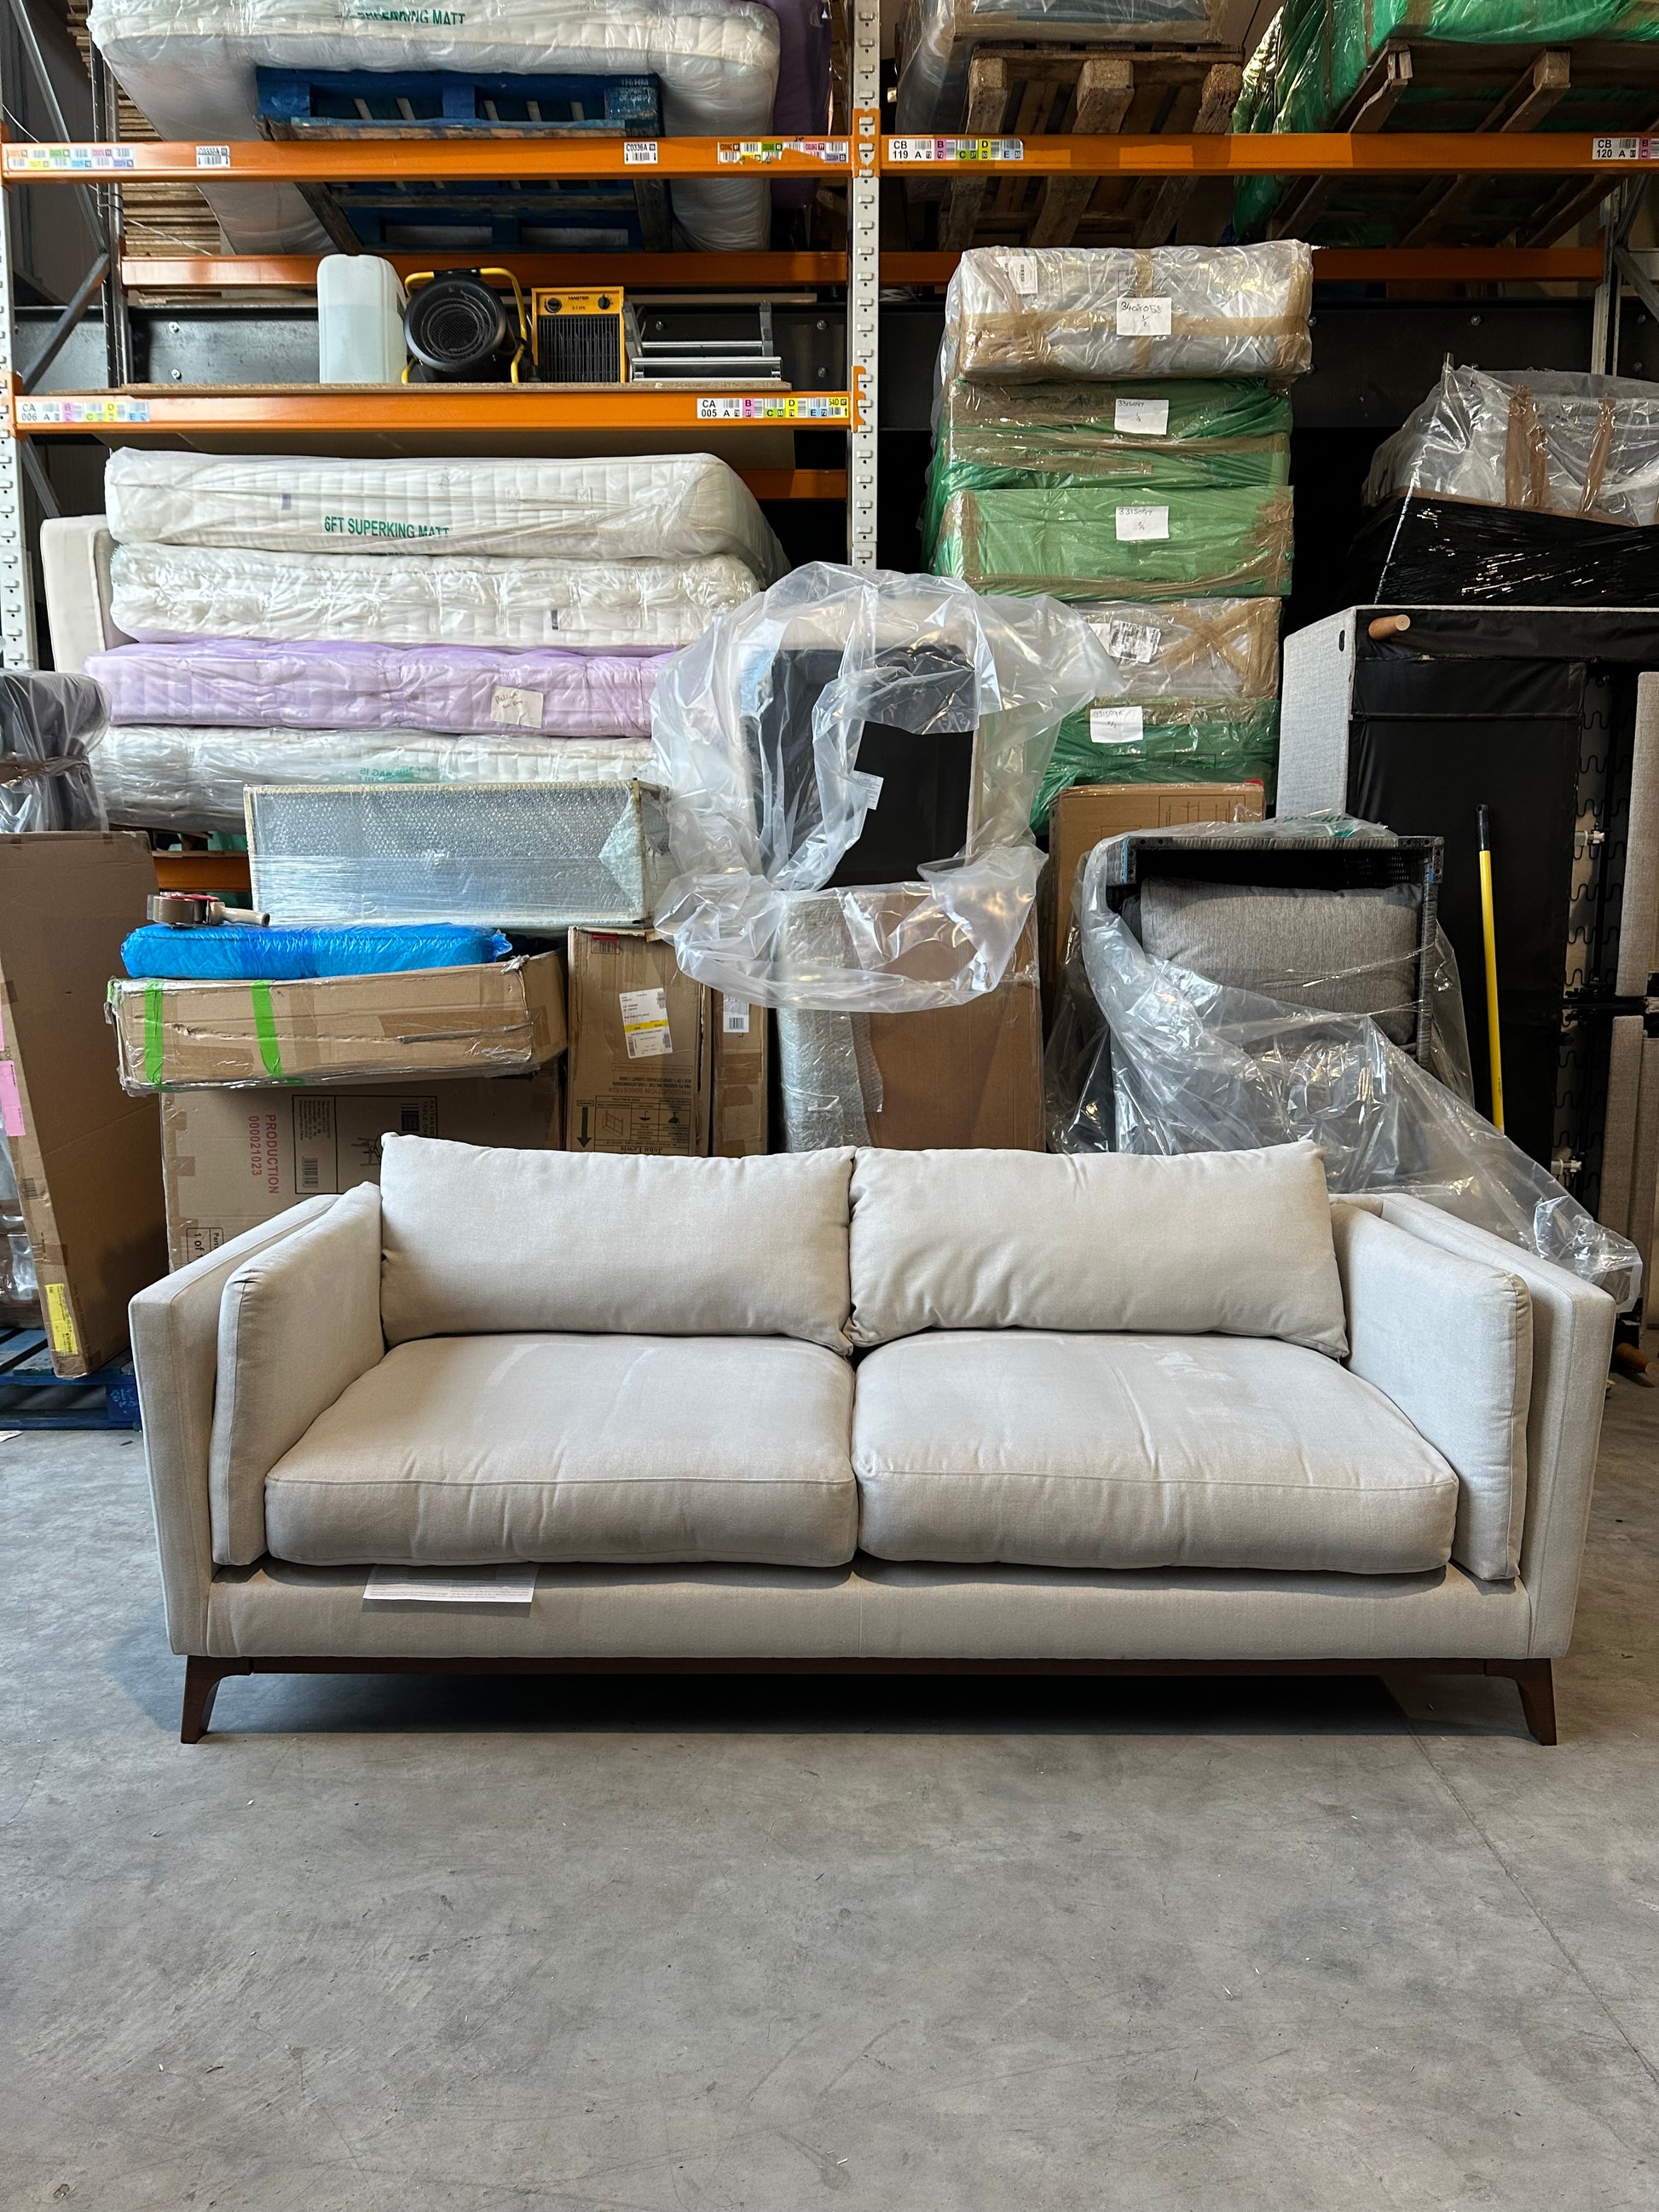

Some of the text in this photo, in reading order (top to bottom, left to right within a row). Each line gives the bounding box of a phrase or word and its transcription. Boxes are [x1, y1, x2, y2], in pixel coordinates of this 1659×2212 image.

[432, 9, 465, 26] MATT
[893, 141, 908, 149] CB
[1598, 139, 1612, 148] CB
[1642, 139, 1649, 147] B
[893, 150, 909, 159] 119
[1597, 149, 1613, 158] 120
[22, 403, 36, 413] CA
[702, 399, 716, 408] CA
[21, 413, 38, 421] 006
[324, 516, 450, 538] 6FT SUPERKING MATT
[248, 1115, 263, 1176] 000021023
[265, 1114, 280, 1193] PRODUCTION
